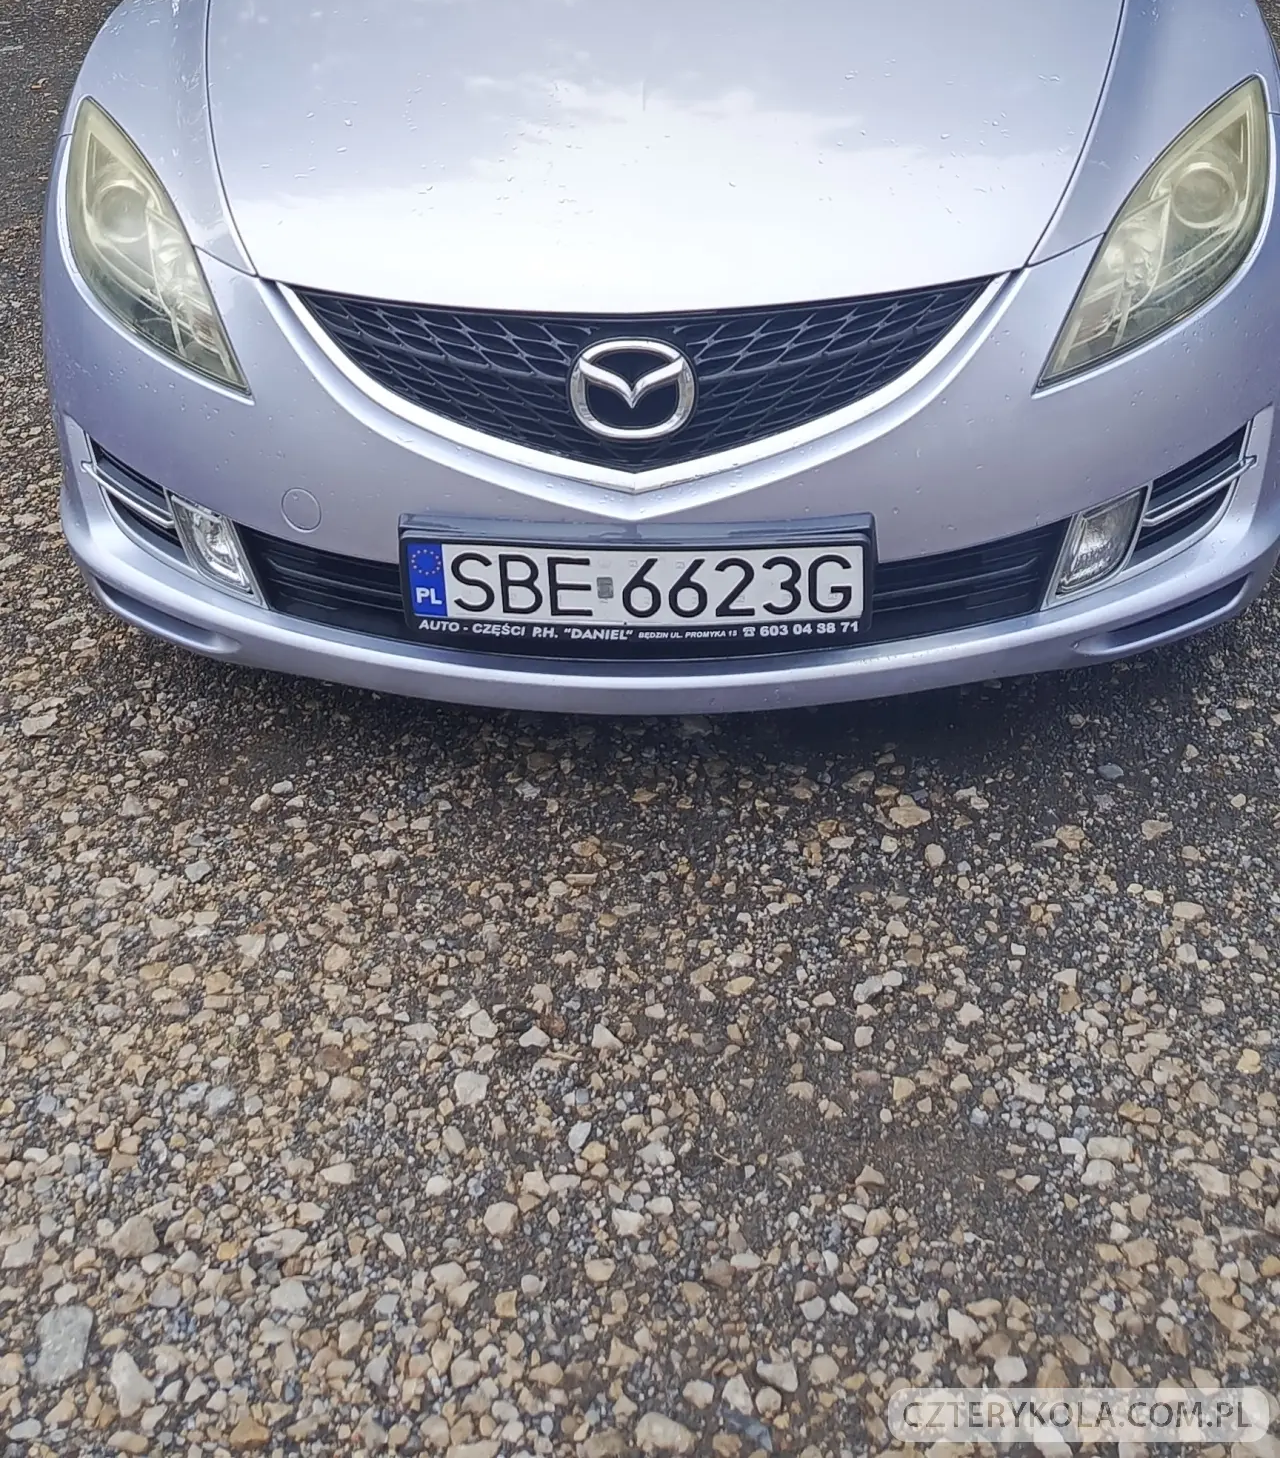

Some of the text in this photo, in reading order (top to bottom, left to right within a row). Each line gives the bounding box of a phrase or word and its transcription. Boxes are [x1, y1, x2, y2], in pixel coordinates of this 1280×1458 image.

[450, 552, 853, 619] SBE 6623G
[416, 586, 443, 606] PL
[418, 620, 460, 633] AUTO
[472, 622, 525, 637] CZĘŚCI
[638, 630, 669, 640] BĘDZIN
[684, 630, 727, 639] PROMYKA
[759, 624, 789, 637] 603
[792, 623, 813, 635] 04
[816, 622, 837, 634] 38
[840, 620, 859, 633] 71
